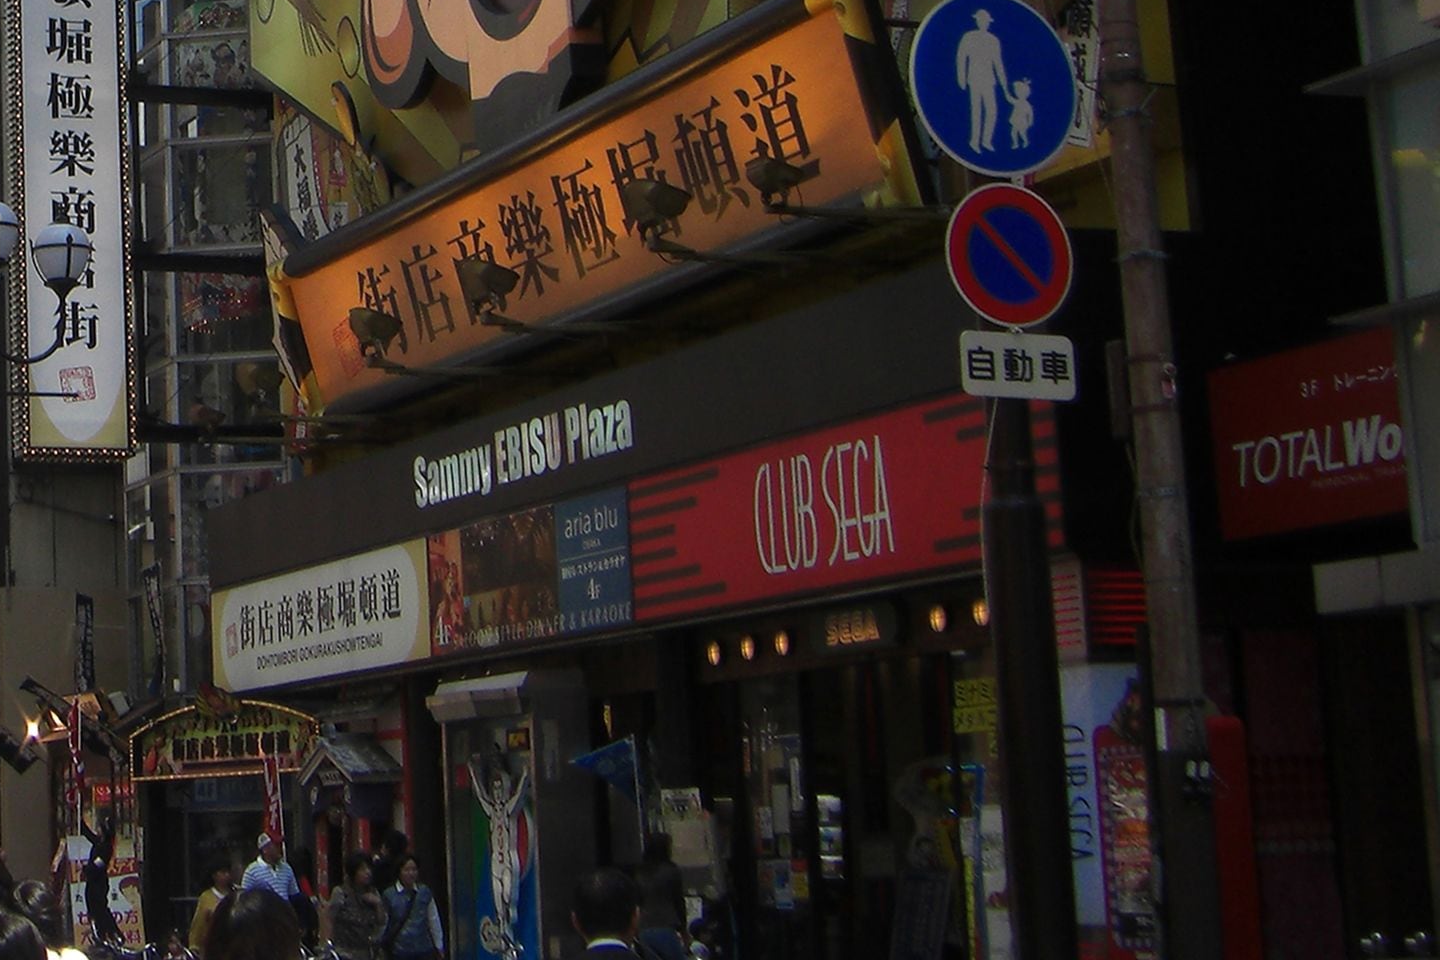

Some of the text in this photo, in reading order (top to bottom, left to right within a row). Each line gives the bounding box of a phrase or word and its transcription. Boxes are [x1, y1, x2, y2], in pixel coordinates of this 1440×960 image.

[967, 346, 1070, 385] 自動車
[1332, 365, 1399, 392] トレーニン
[413, 397, 633, 510] Sammy EBISU Plaza
[564, 505, 618, 539] aria blu
[753, 434, 896, 575] CLUB SEGA
[587, 578, 601, 600] 4F
[825, 610, 880, 646] SEGA
